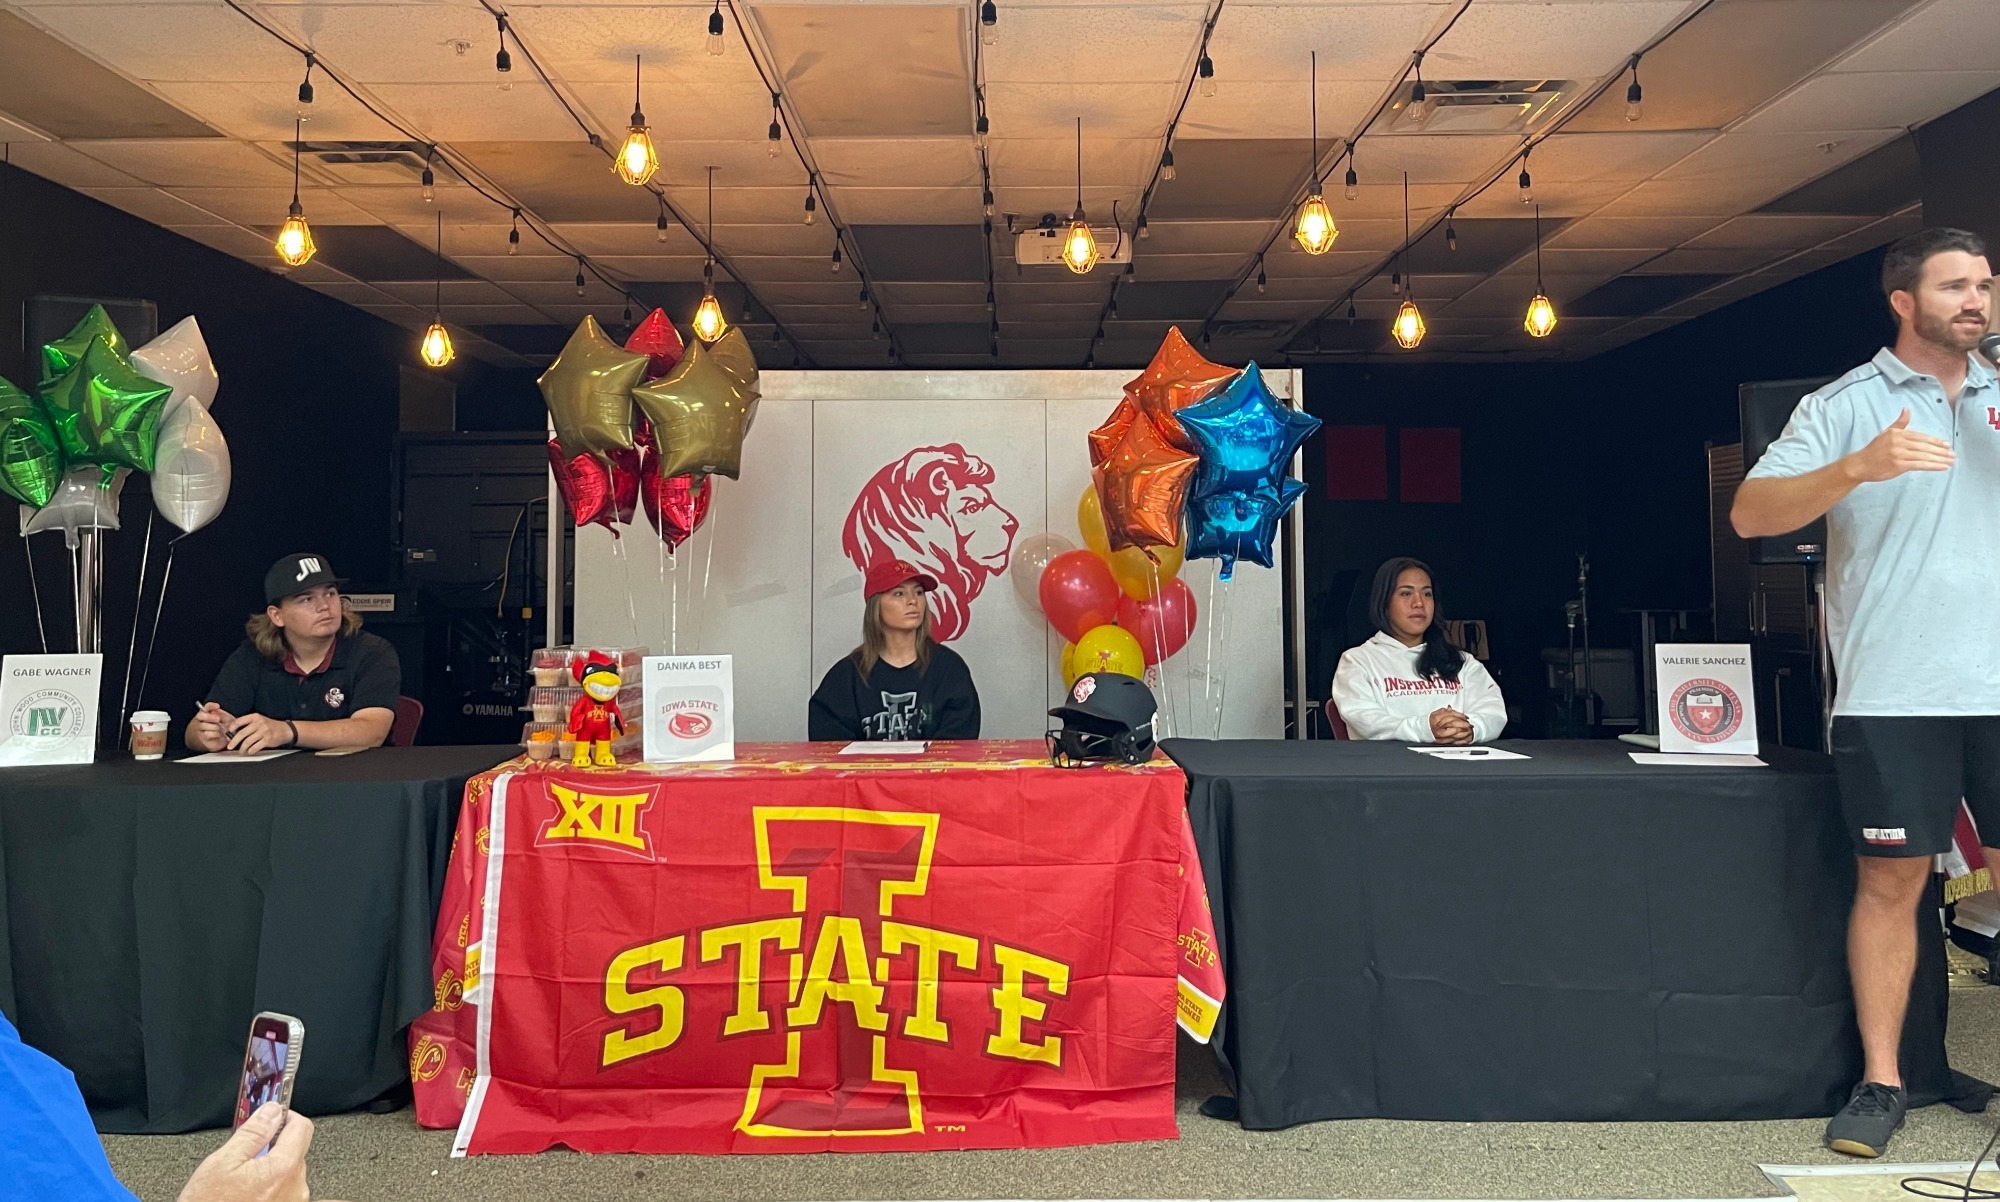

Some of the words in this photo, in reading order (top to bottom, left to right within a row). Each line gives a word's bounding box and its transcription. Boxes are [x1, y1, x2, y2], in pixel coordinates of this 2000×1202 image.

[657, 662, 696, 671] DANIKA
[698, 660, 722, 670] BEST
[1662, 657, 1700, 665] VALERIE
[1702, 657, 1746, 666] SANCHEZ
[13, 668, 42, 676] GABE
[44, 668, 92, 676] WAGNER
[1386, 690, 1432, 698] ACADEMY
[17, 696, 34, 712] WOOD
[36, 691, 78, 706] COMMUNITY
[70, 706, 82, 736] COLLEGE
[474, 704, 514, 716] YAMAHA
[662, 700, 687, 714] IOWA
[688, 700, 719, 712] STATE
[40, 728, 62, 736] CC
[1177, 934, 1217, 966] STATE
[433, 968, 454, 1013] CYCLONES
[600, 915, 1071, 1068] STATE
[1177, 1001, 1201, 1023] CLONES
[1184, 997, 1203, 1015] STATE
